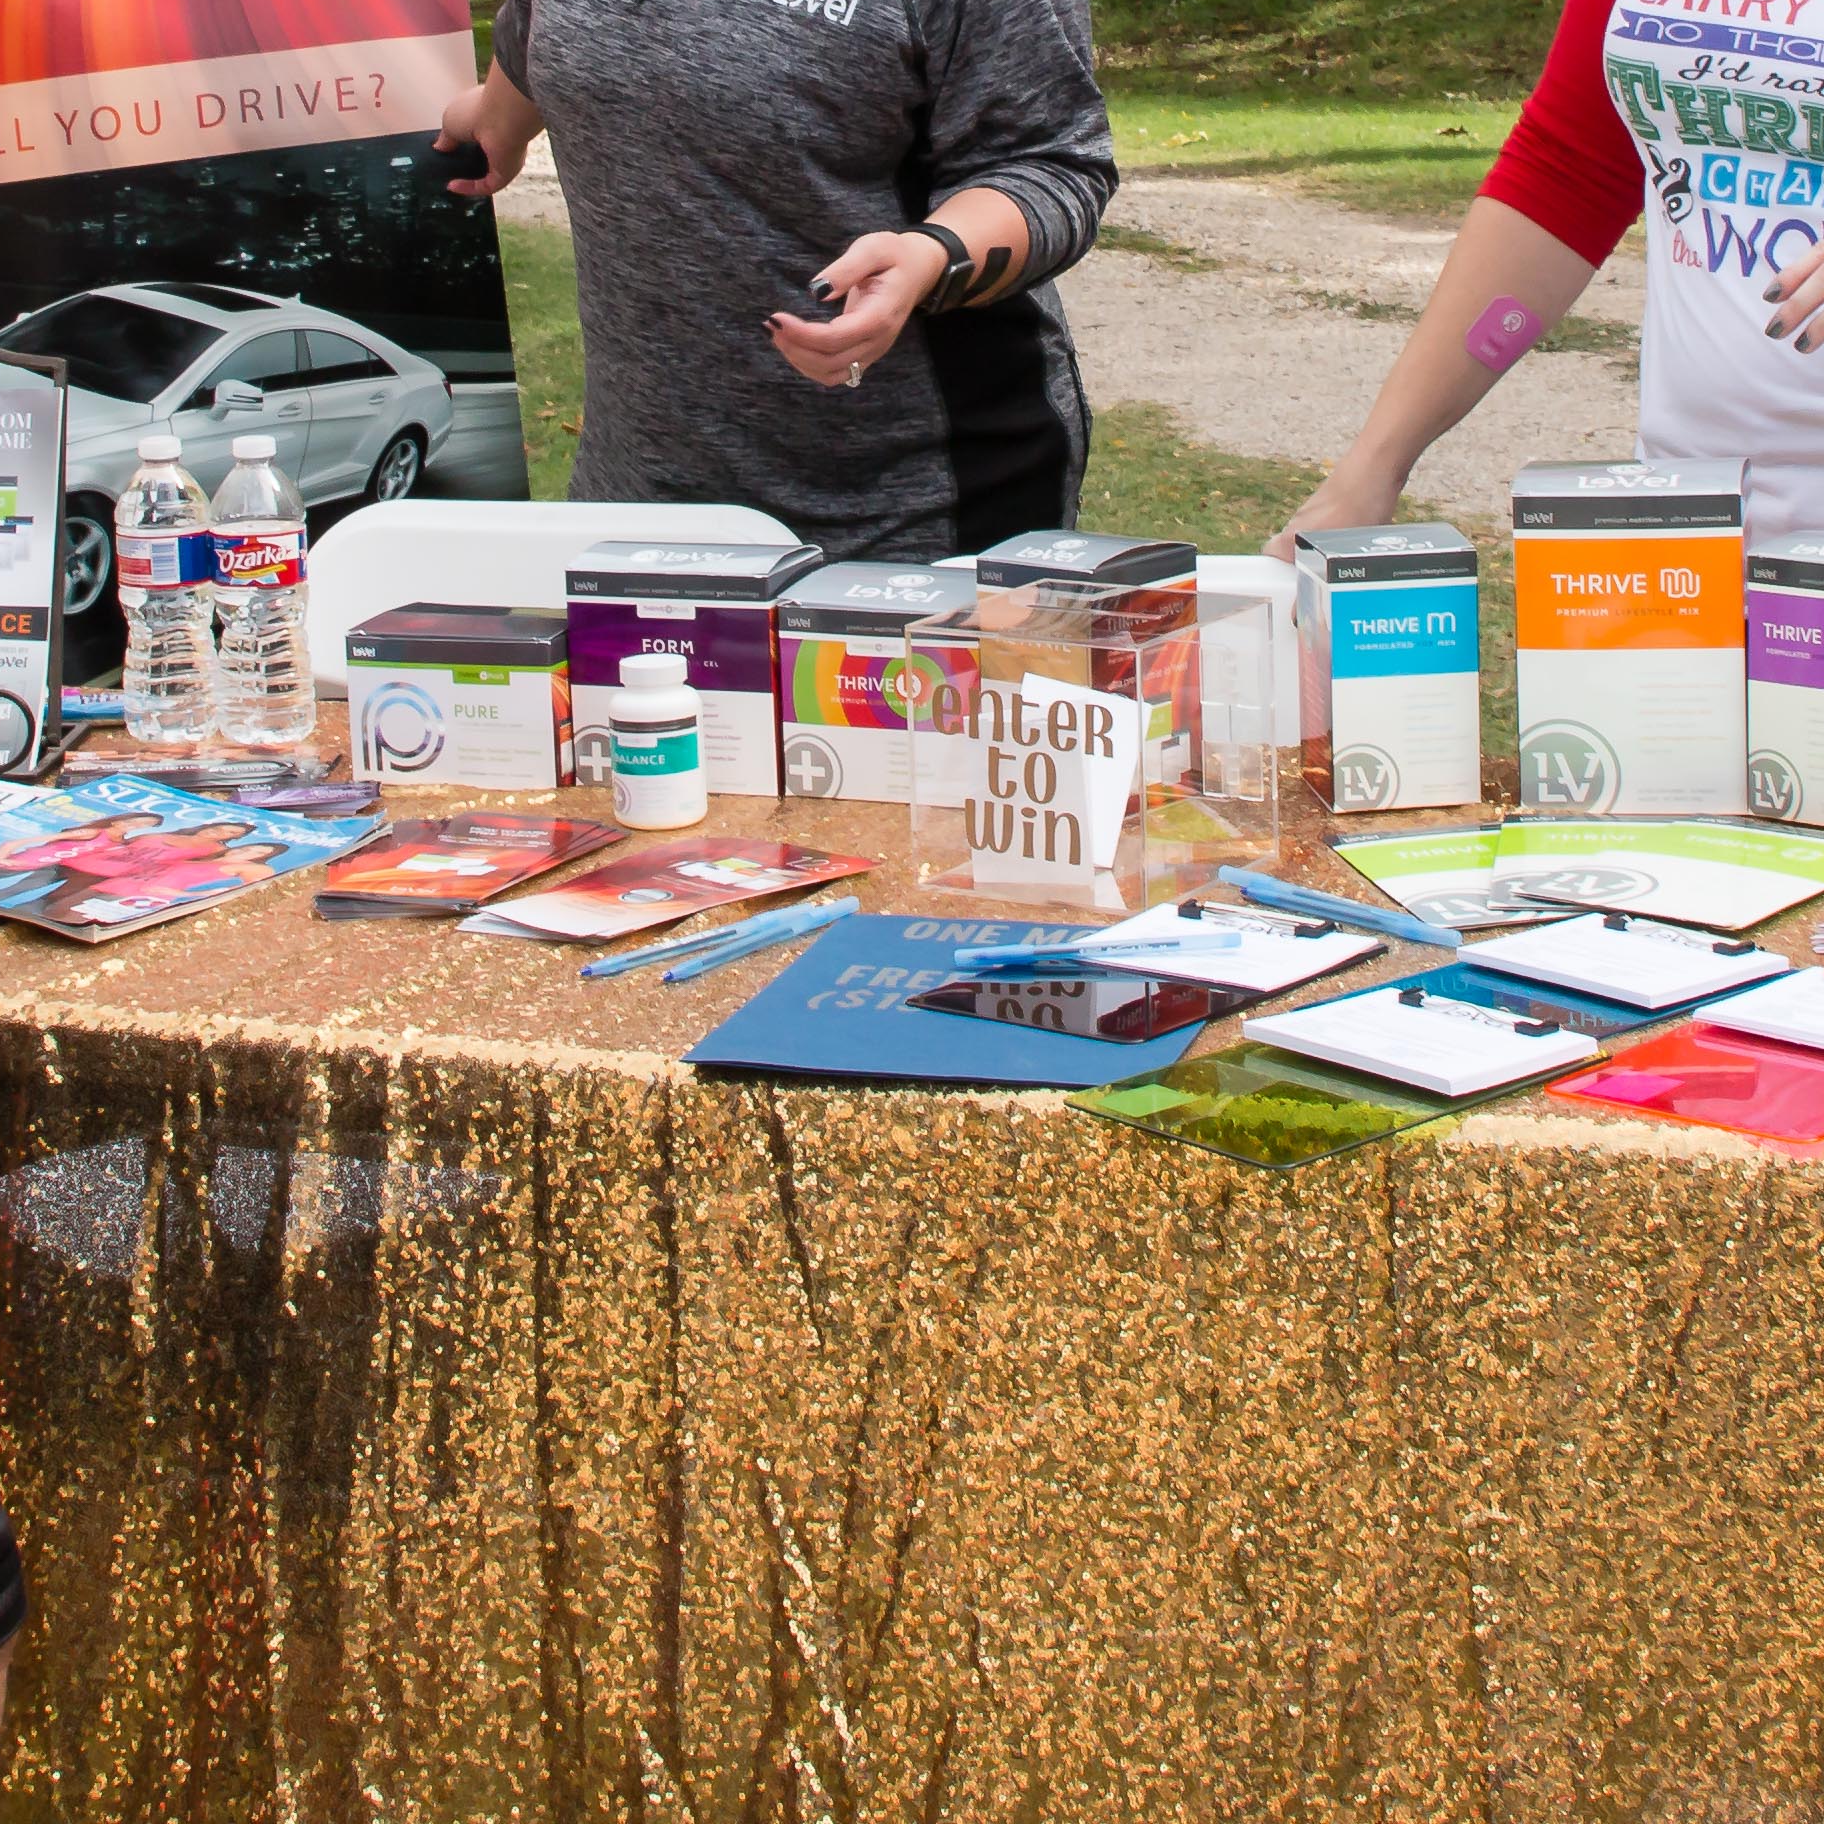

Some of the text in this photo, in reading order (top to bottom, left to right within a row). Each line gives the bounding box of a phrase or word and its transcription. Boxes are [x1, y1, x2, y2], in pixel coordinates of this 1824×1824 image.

[53, 97, 165, 146] YOU
[197, 72, 390, 132] DRIVE?
[1550, 572, 1648, 595] THRIVE
[1556, 607, 1609, 617] PREMIUM
[1678, 607, 1700, 616] MIX
[1349, 616, 1421, 636] THRIVE
[1762, 621, 1822, 645] THRIVE
[641, 637, 695, 655] FORM
[835, 674, 895, 693] THRIVE
[453, 703, 499, 720] PURE
[613, 753, 666, 766] BALANCE
[987, 745, 1058, 805] to
[964, 797, 1082, 867] win
[902, 920, 1010, 945] ONE
